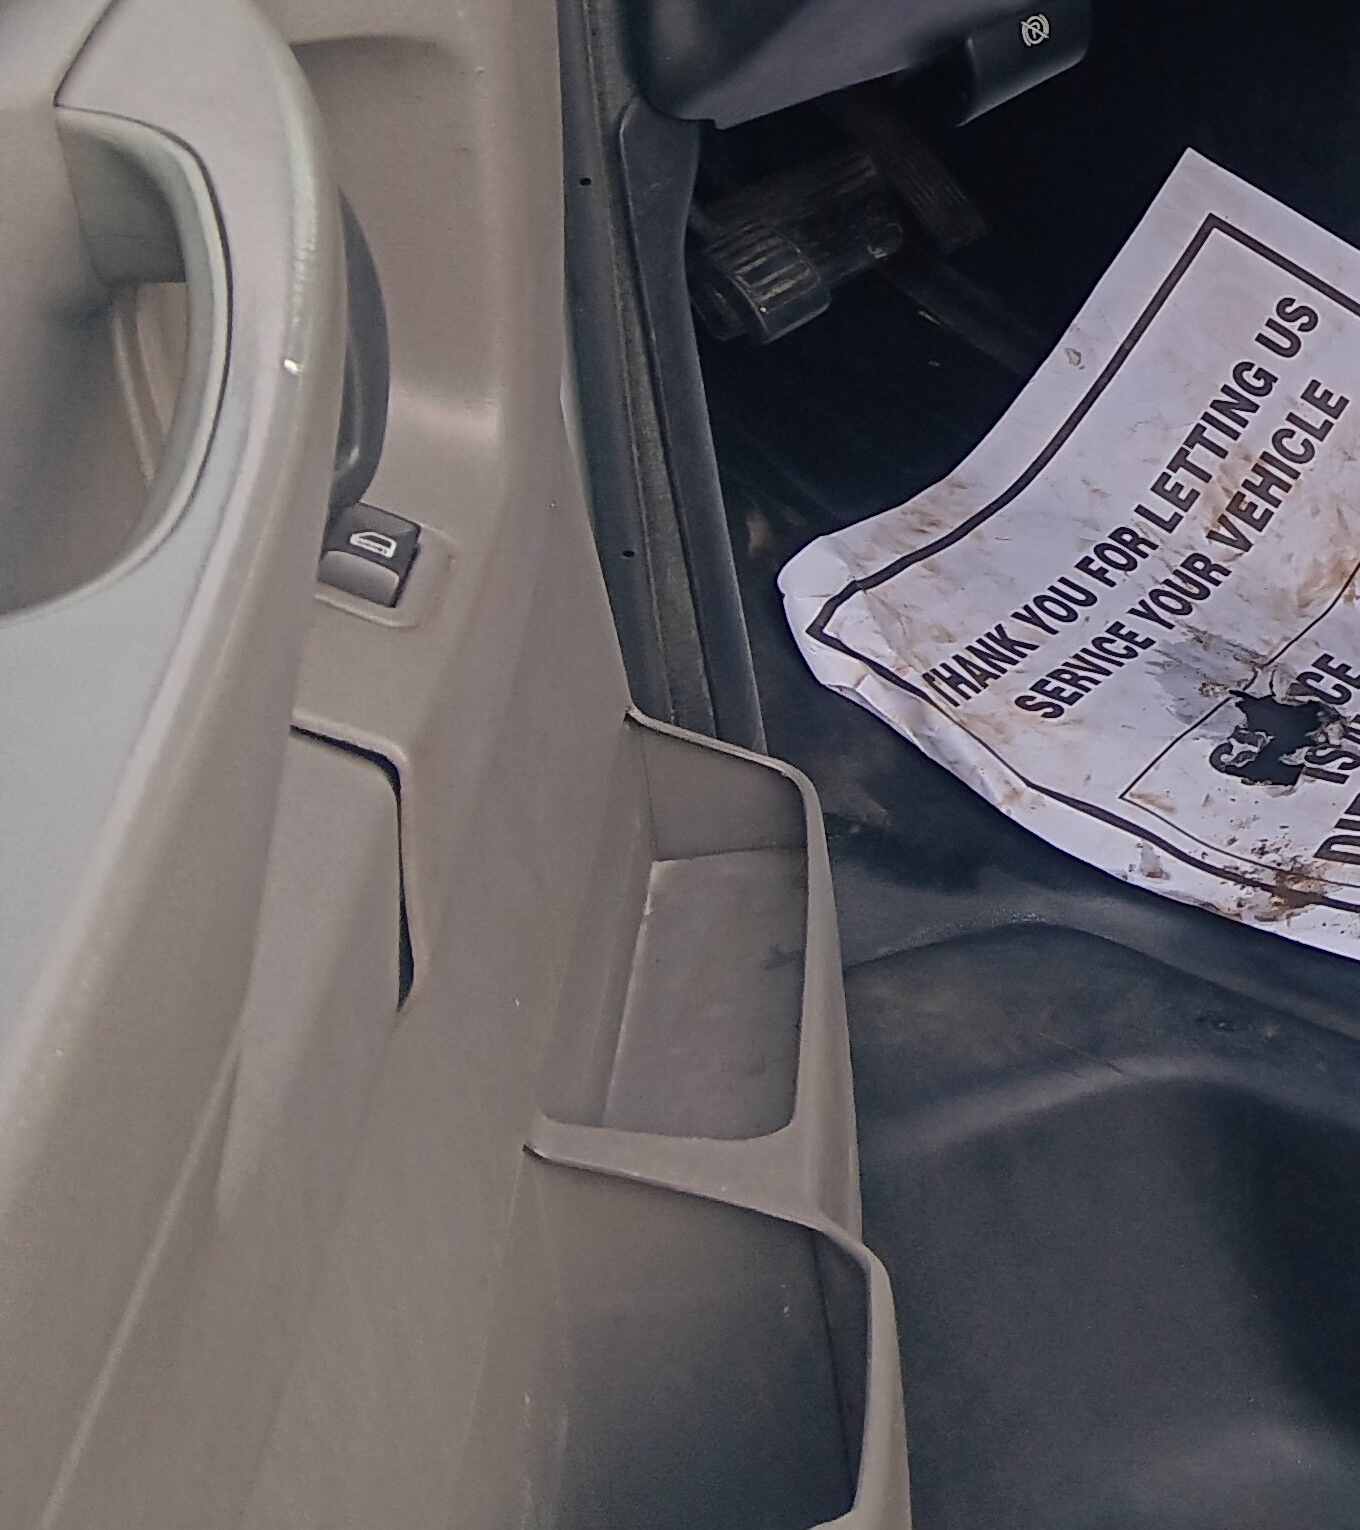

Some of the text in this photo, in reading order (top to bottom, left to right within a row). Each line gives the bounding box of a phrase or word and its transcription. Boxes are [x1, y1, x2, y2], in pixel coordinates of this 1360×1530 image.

[922, 296, 1320, 708] THANK YOU FOR LETTING US
[1014, 620, 1157, 720] SERVICE
[1127, 551, 1233, 631] YOUR
[1206, 378, 1350, 553] VEHICLE
